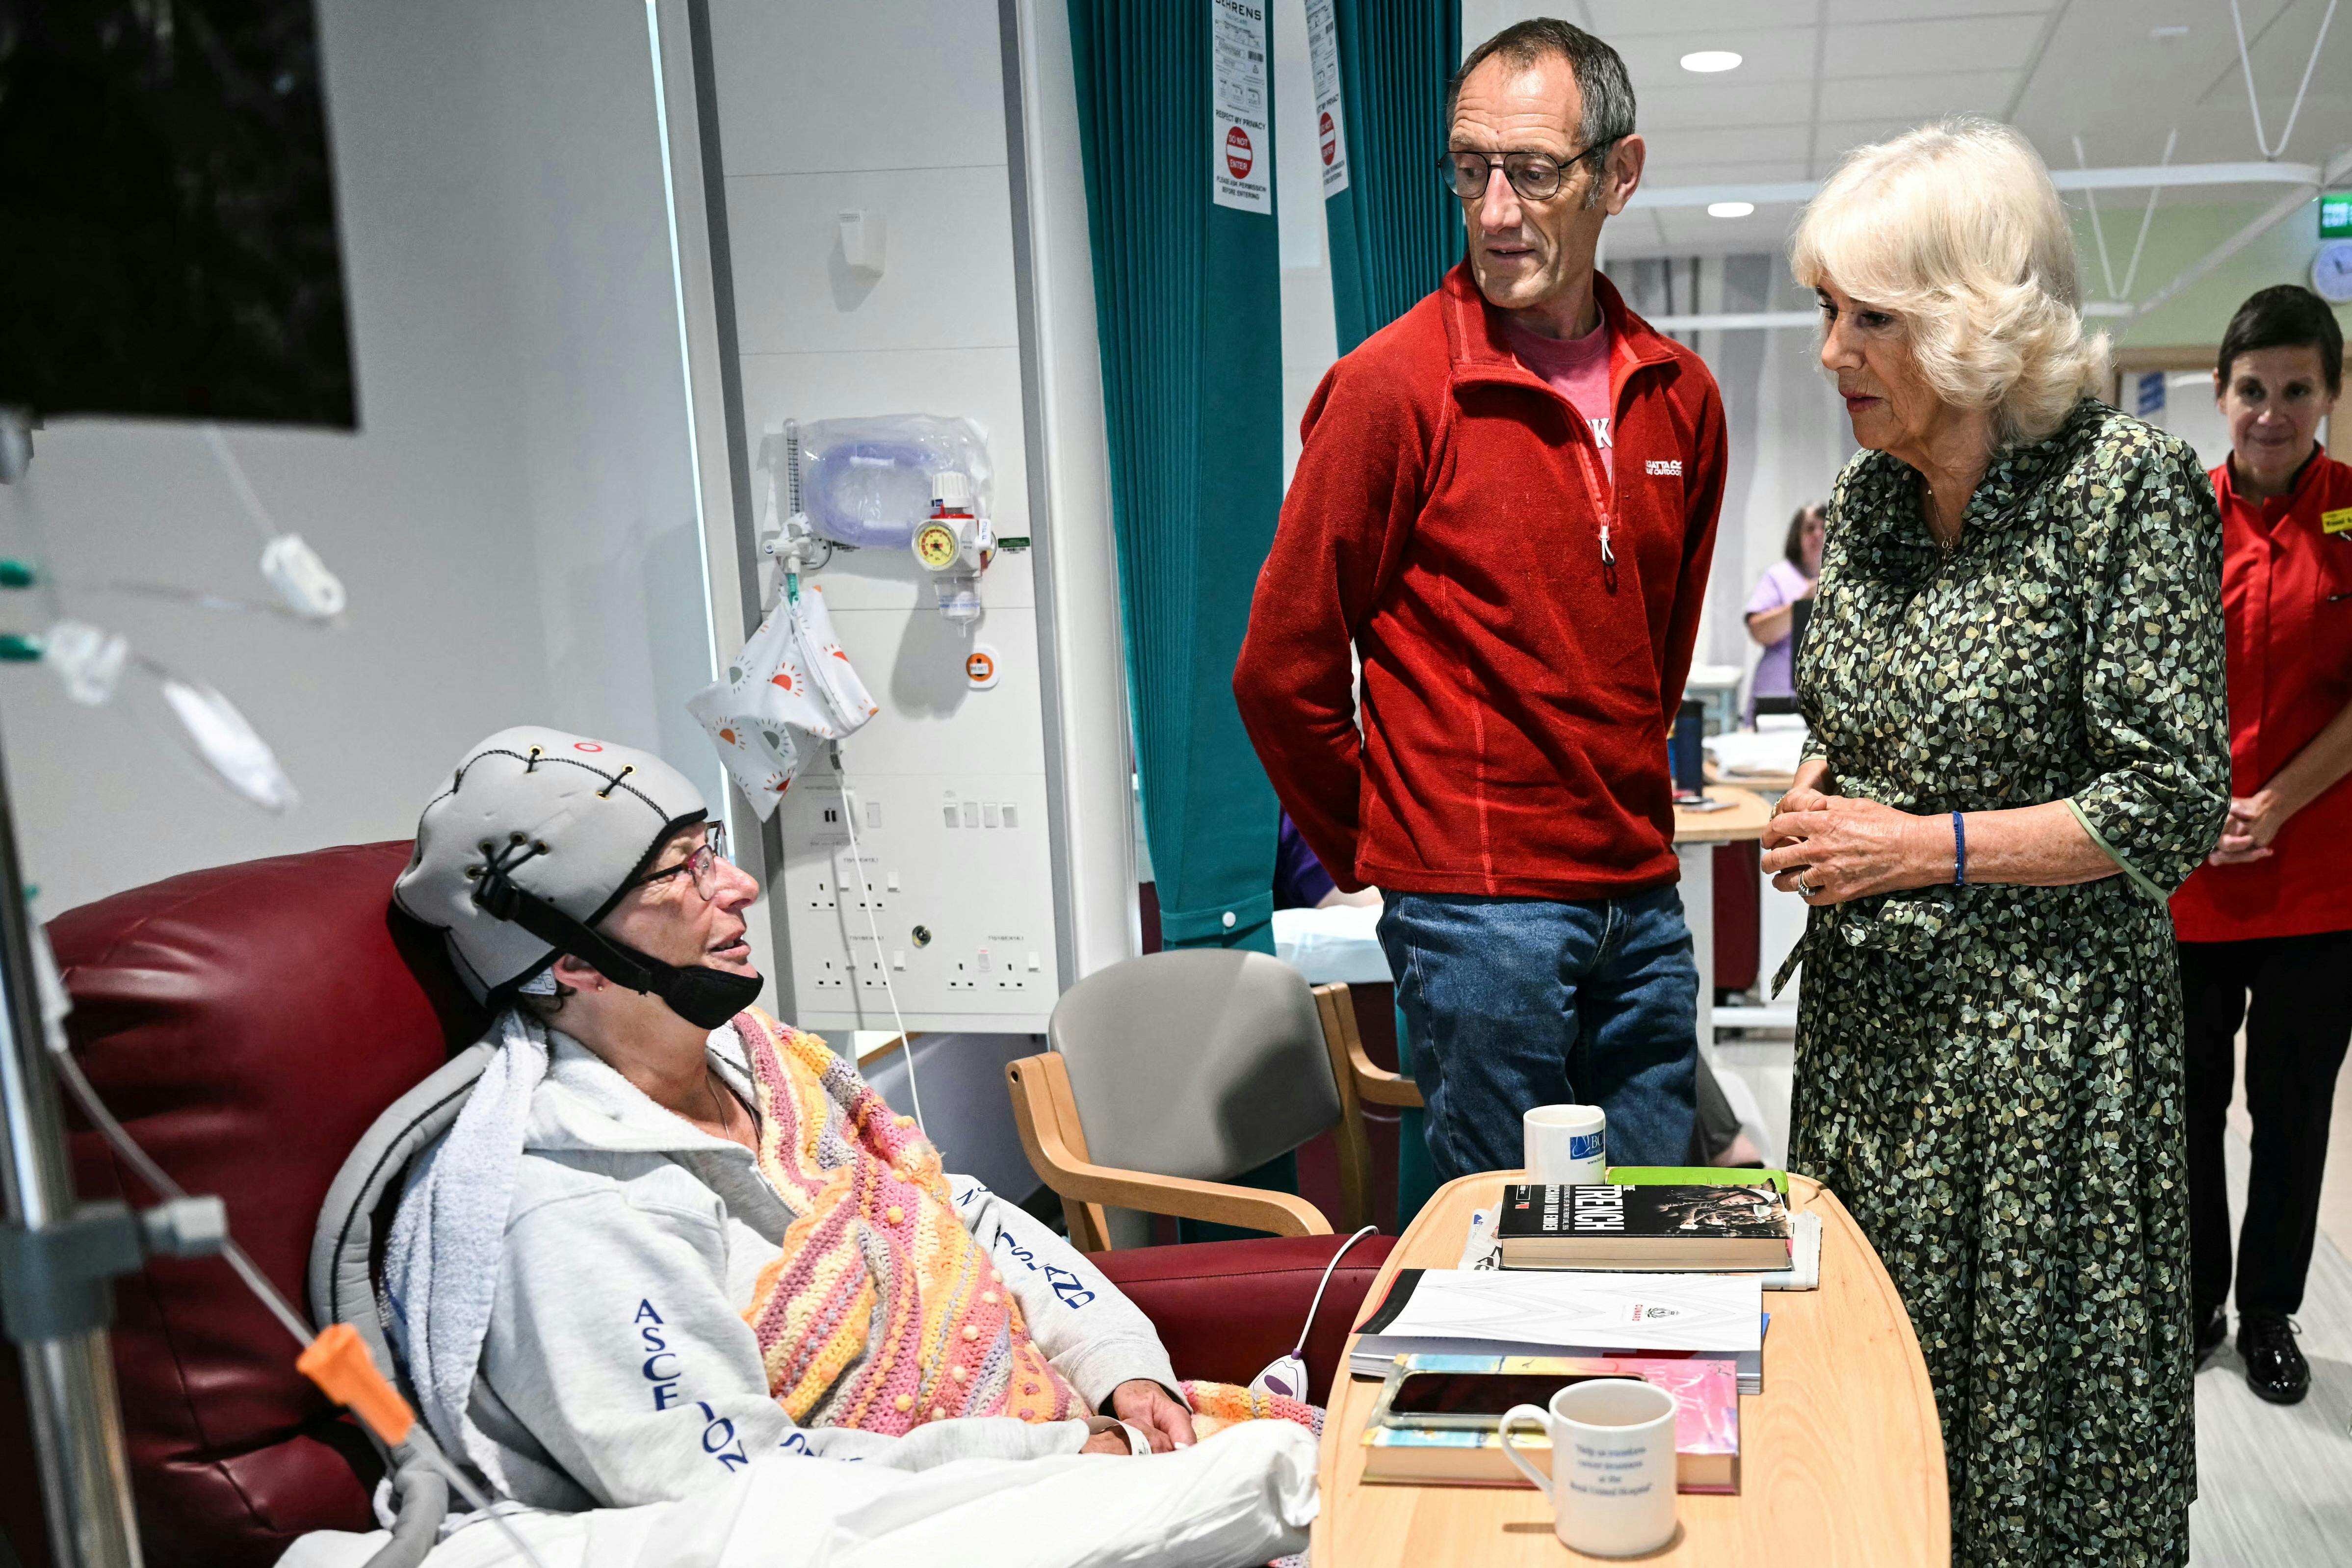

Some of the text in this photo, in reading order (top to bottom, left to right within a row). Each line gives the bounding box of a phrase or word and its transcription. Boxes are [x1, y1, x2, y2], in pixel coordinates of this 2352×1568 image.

[1216, 109, 1234, 122] RESPECT
[1243, 118, 1266, 131] PRIVACY
[1228, 134, 1248, 146] DO NOT
[1229, 159, 1248, 171] ENTER
[1236, 190, 1260, 200] ENTERING
[1239, 182, 1267, 192] PERMISSION
[1542, 1185, 1560, 1230] RICHARD VAN EMDEN
[1574, 1185, 1625, 1230] TRENCH
[1001, 1232, 1096, 1309] ISLAND
[1632, 1305, 1643, 1321] CUNARD
